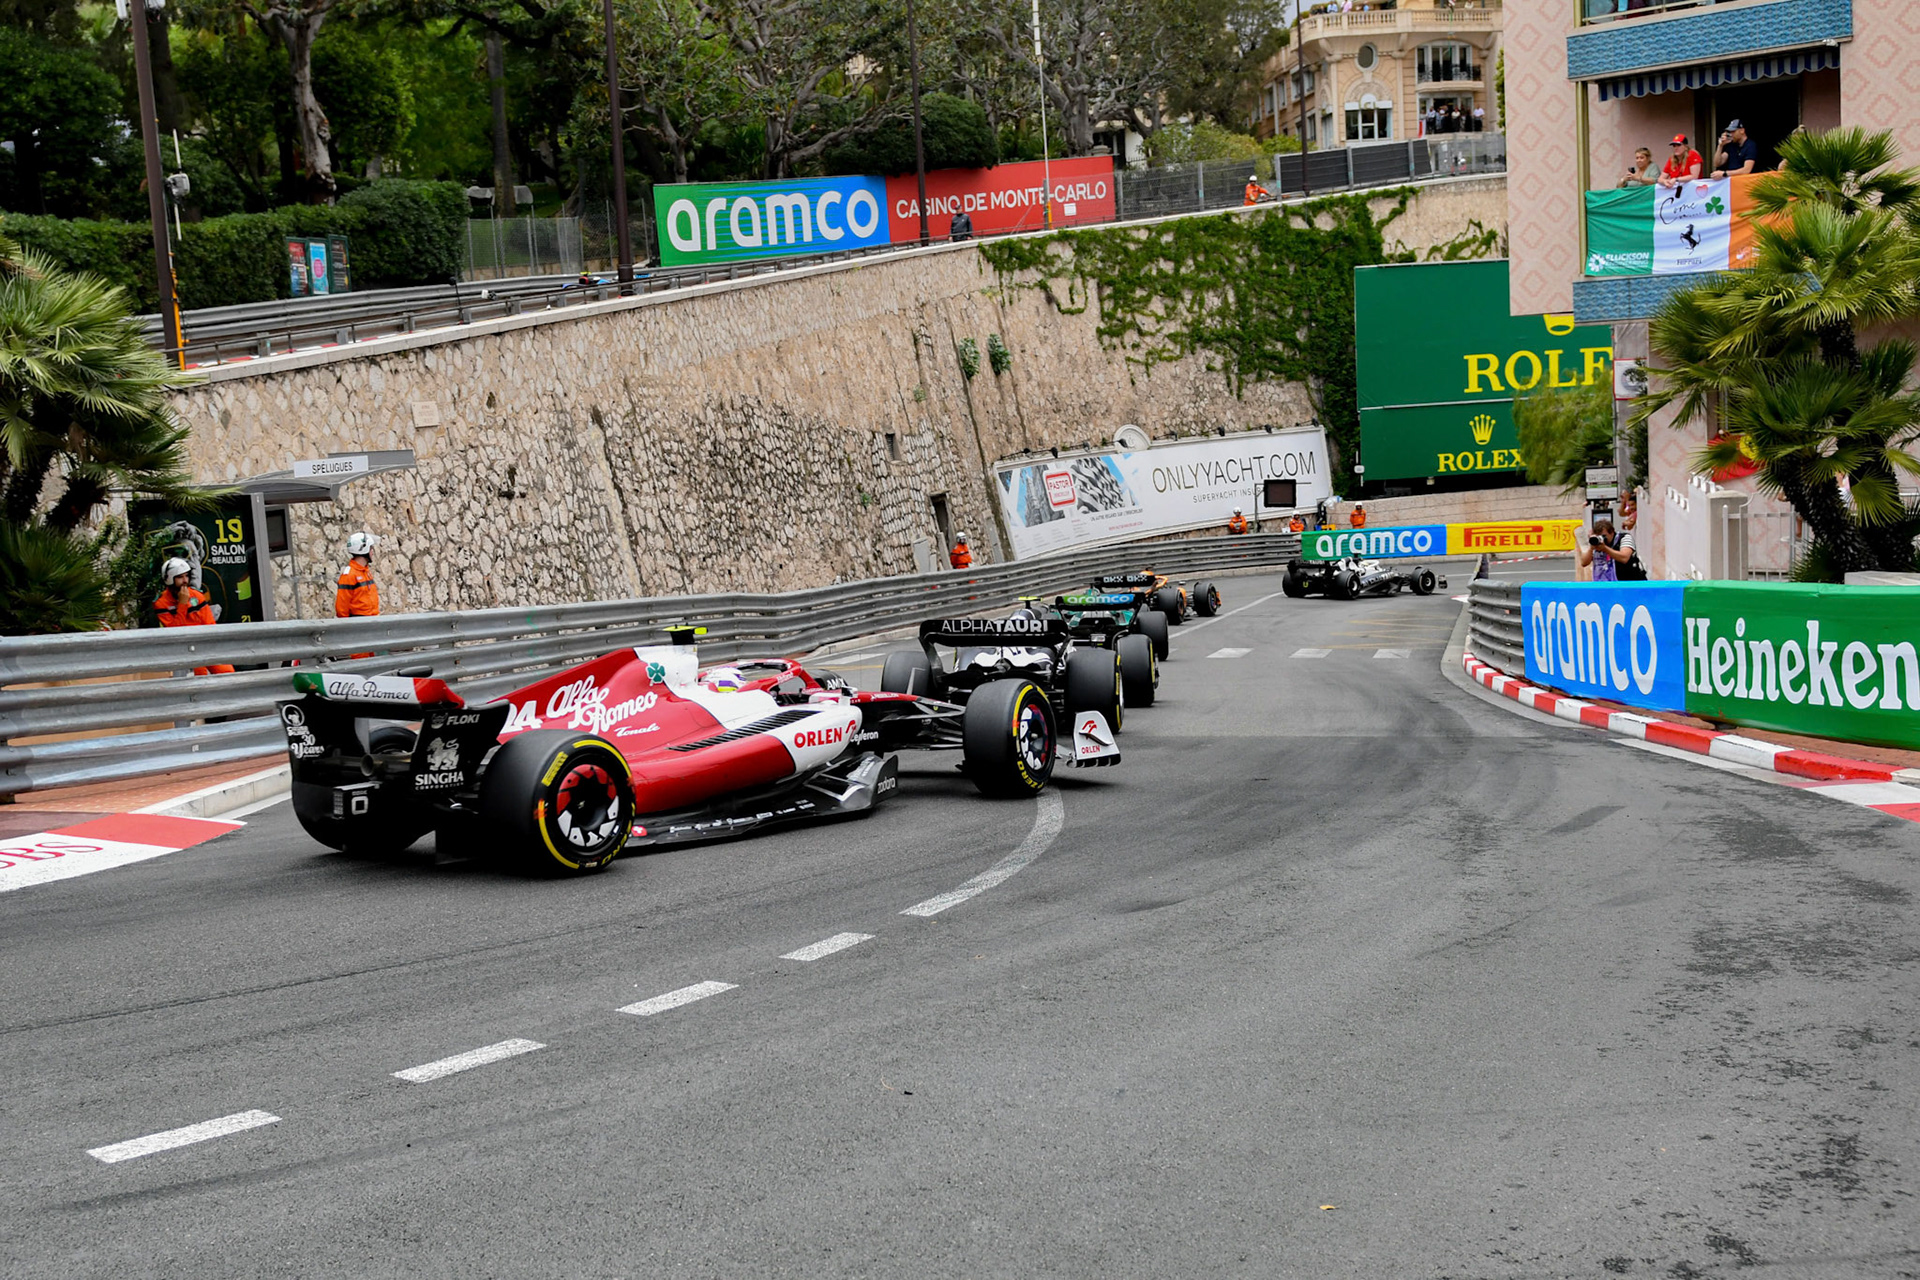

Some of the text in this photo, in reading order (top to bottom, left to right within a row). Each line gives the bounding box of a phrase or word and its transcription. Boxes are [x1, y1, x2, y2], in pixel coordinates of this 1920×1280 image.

[896, 180, 1107, 219] CASINO DE MONTE-CARLO
[667, 189, 879, 252] aramco
[312, 461, 353, 474] SPÉLUGUES
[1437, 449, 1527, 472] ROLEX
[1152, 451, 1316, 493] ONLYYACHT.COM
[1193, 490, 1237, 503] SUPERYACHT
[215, 518, 243, 543] 19
[1464, 525, 1544, 547] PIRELLI
[211, 544, 246, 555] SALON
[1316, 530, 1432, 558] aramco
[211, 556, 247, 564] BEAULIEU
[1067, 594, 1131, 603] aramco
[941, 620, 1048, 633] ALPHATAURI
[1532, 600, 1657, 695] aramco
[1685, 617, 1920, 711] Heineken
[329, 681, 411, 700] Alfa Romeo
[546, 675, 658, 735] Alfa Romeo
[446, 714, 480, 725] FLOKI
[614, 723, 660, 737] Tonale
[794, 727, 842, 748] ORLEN
[301, 734, 316, 746] 30
[291, 743, 325, 759] Years
[1081, 744, 1101, 755] ORLEN
[415, 771, 464, 786] SINGHA
